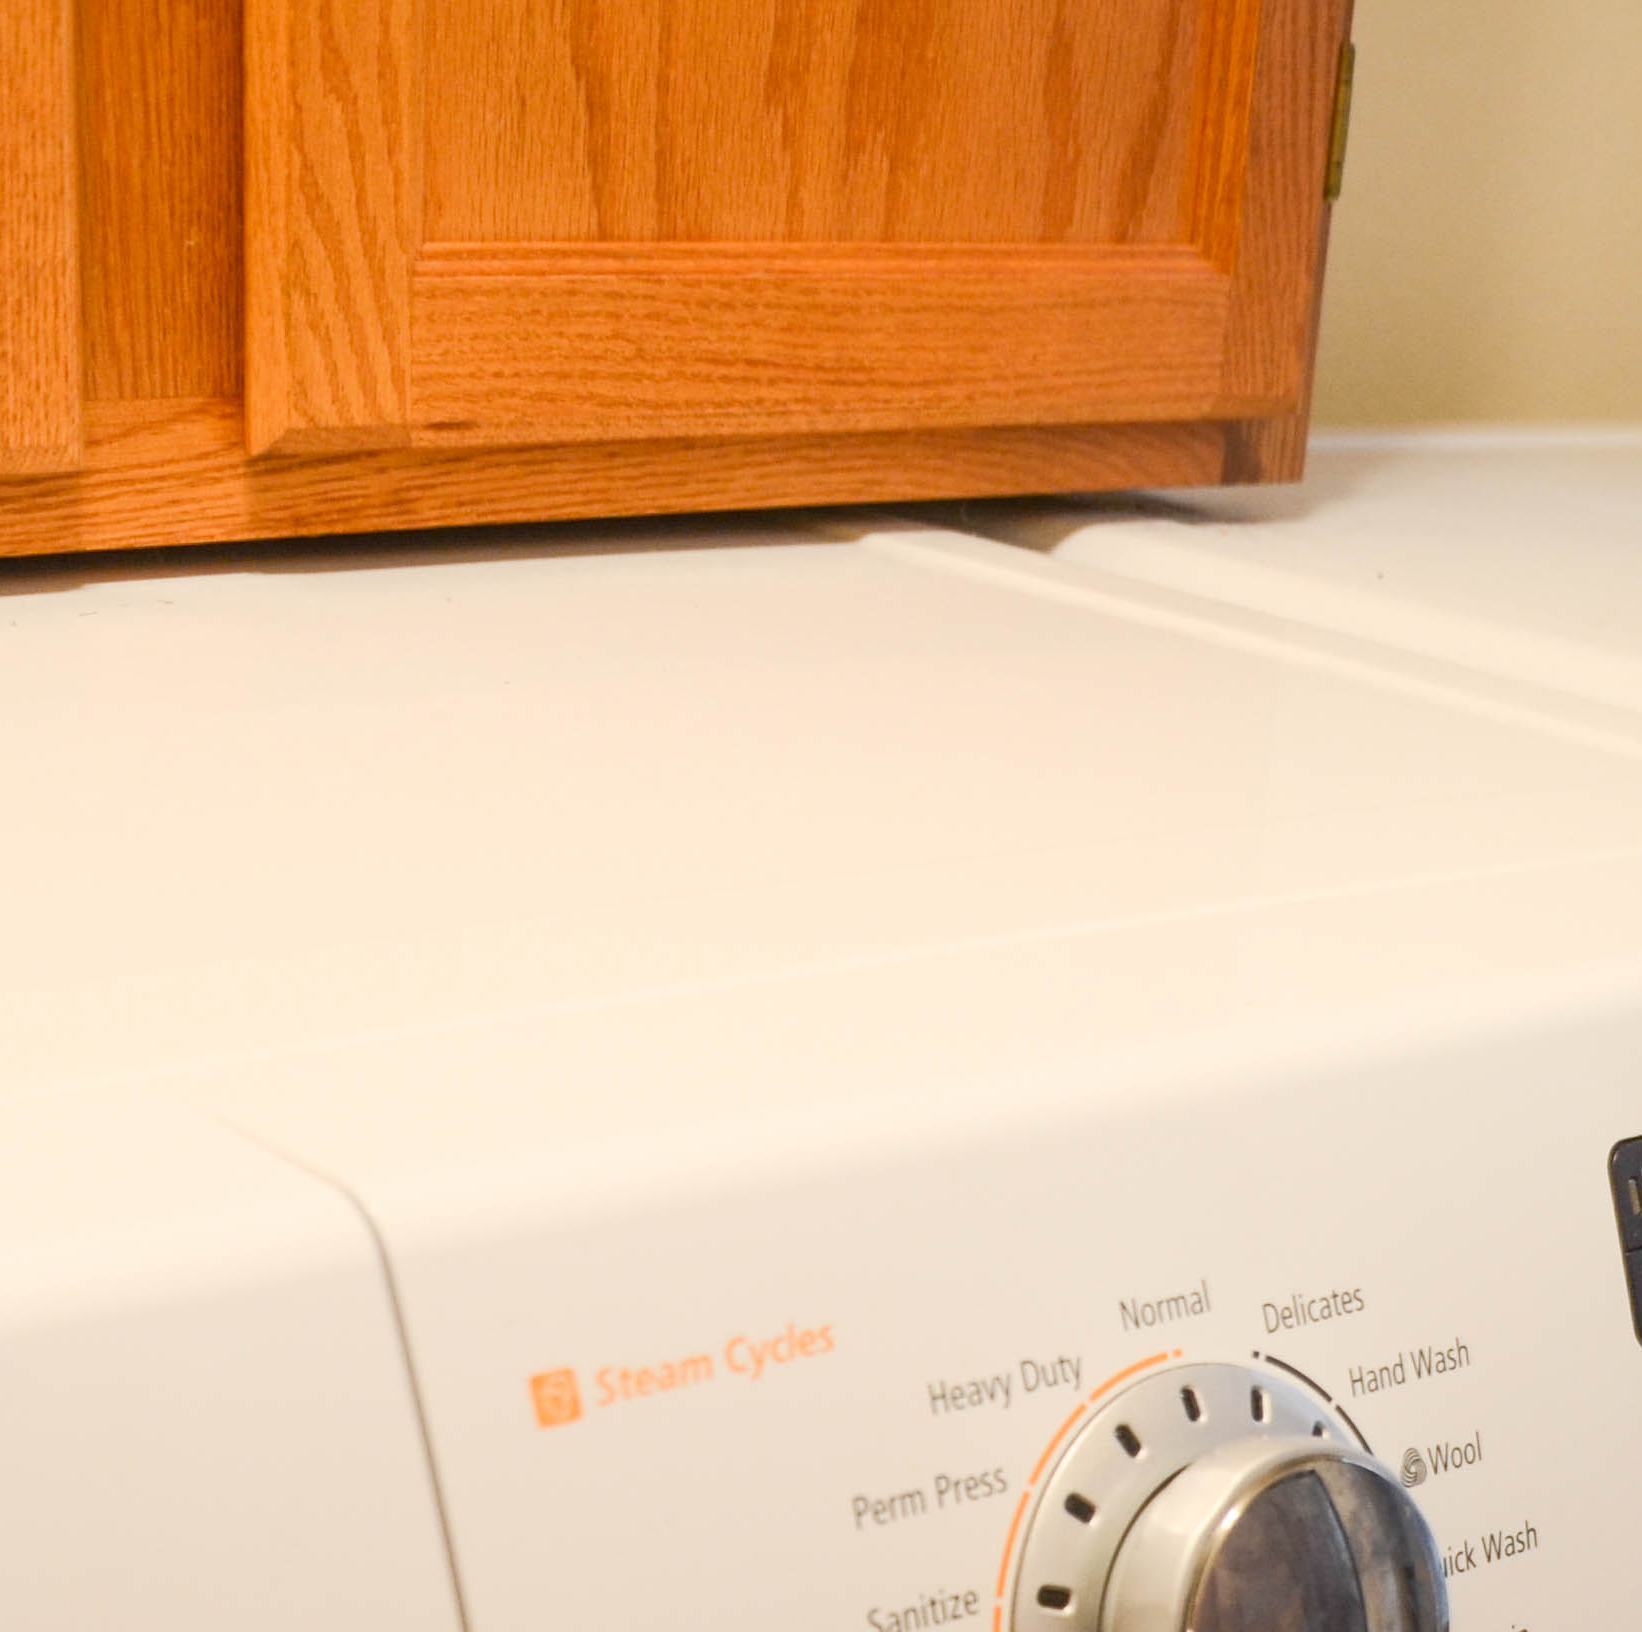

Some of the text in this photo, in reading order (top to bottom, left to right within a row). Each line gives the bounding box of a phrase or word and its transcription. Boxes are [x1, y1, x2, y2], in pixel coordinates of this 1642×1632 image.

[1118, 1279, 1211, 1333] Normal
[1262, 1283, 1365, 1337] Delicates
[595, 1320, 836, 1407] Steam Cycles
[926, 1350, 1084, 1418] Heavy Duty
[1349, 1338, 1471, 1399] Hand Wash
[1426, 1430, 1484, 1476] Wool
[851, 1461, 1010, 1532] Perm Press
[1441, 1518, 1539, 1579] ick Wash
